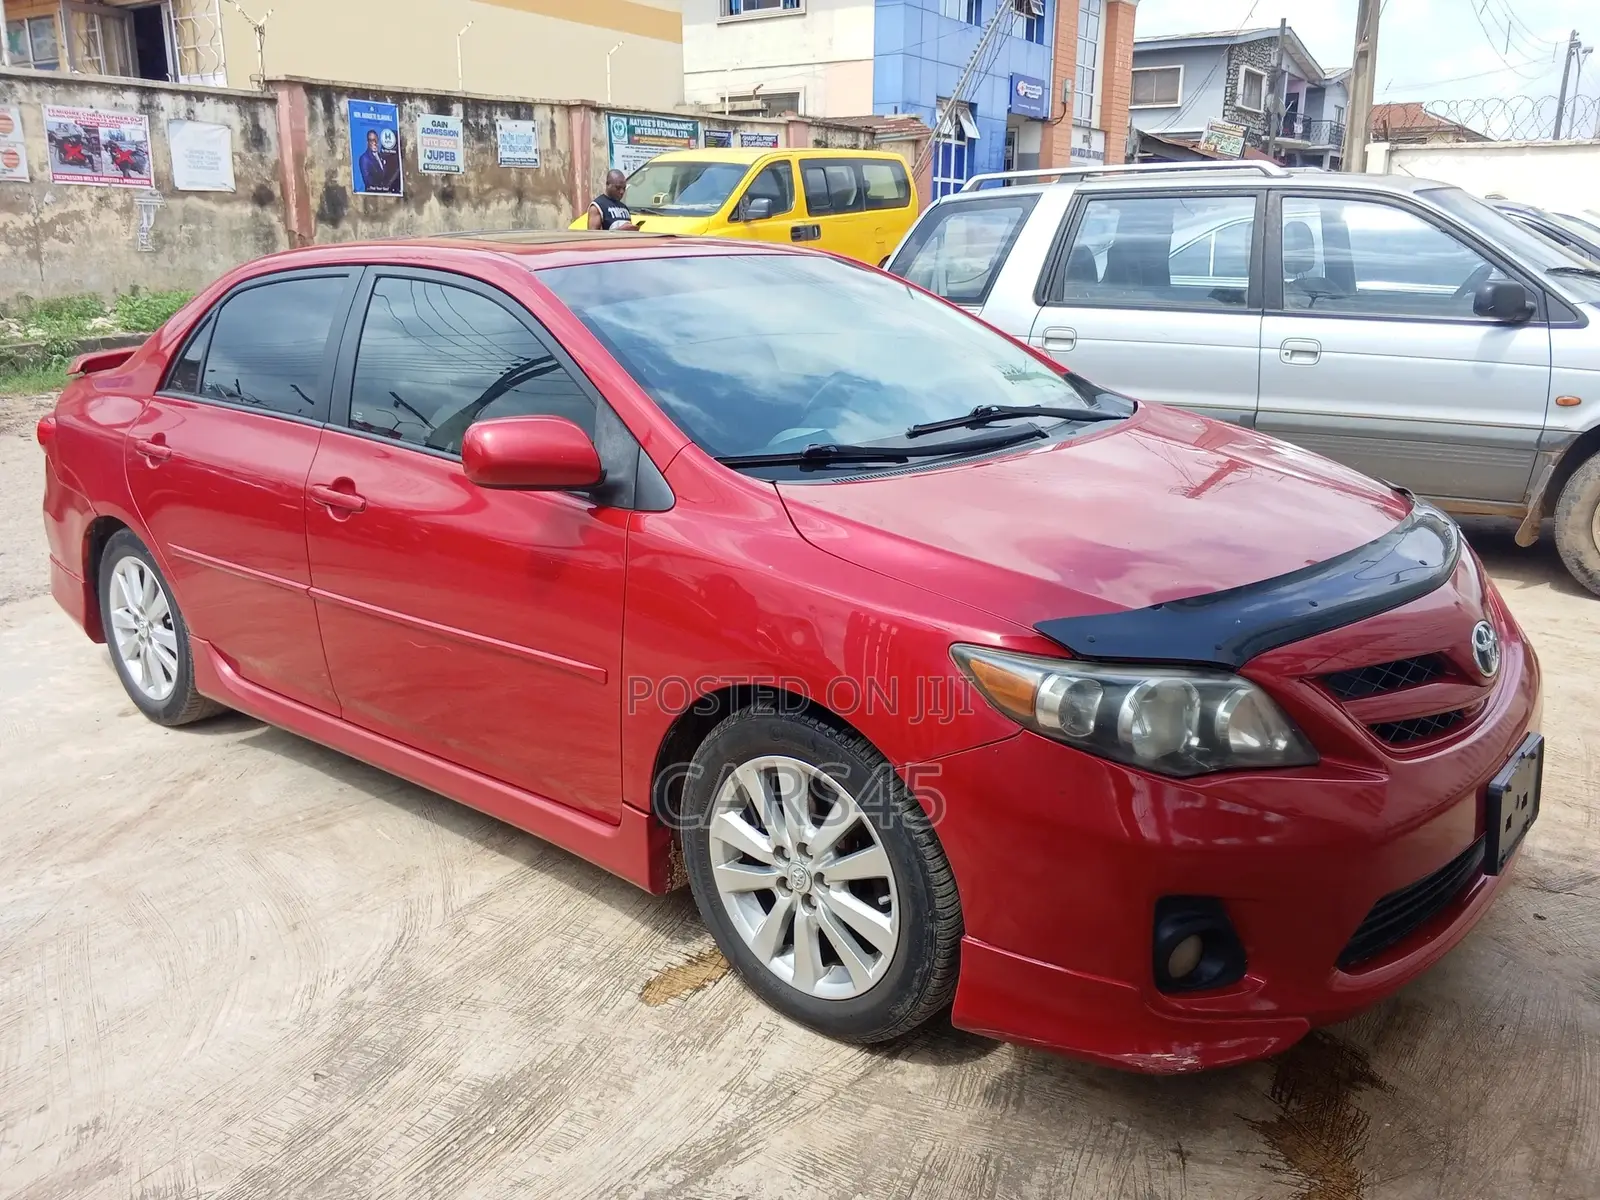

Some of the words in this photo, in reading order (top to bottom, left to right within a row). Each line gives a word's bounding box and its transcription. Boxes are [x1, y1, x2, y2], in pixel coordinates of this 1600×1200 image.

[431, 120, 448, 128] GAIN
[421, 127, 459, 137] ADMISSION
[634, 127, 678, 137] INTERNATIONAL
[427, 150, 455, 161] JUPEB
